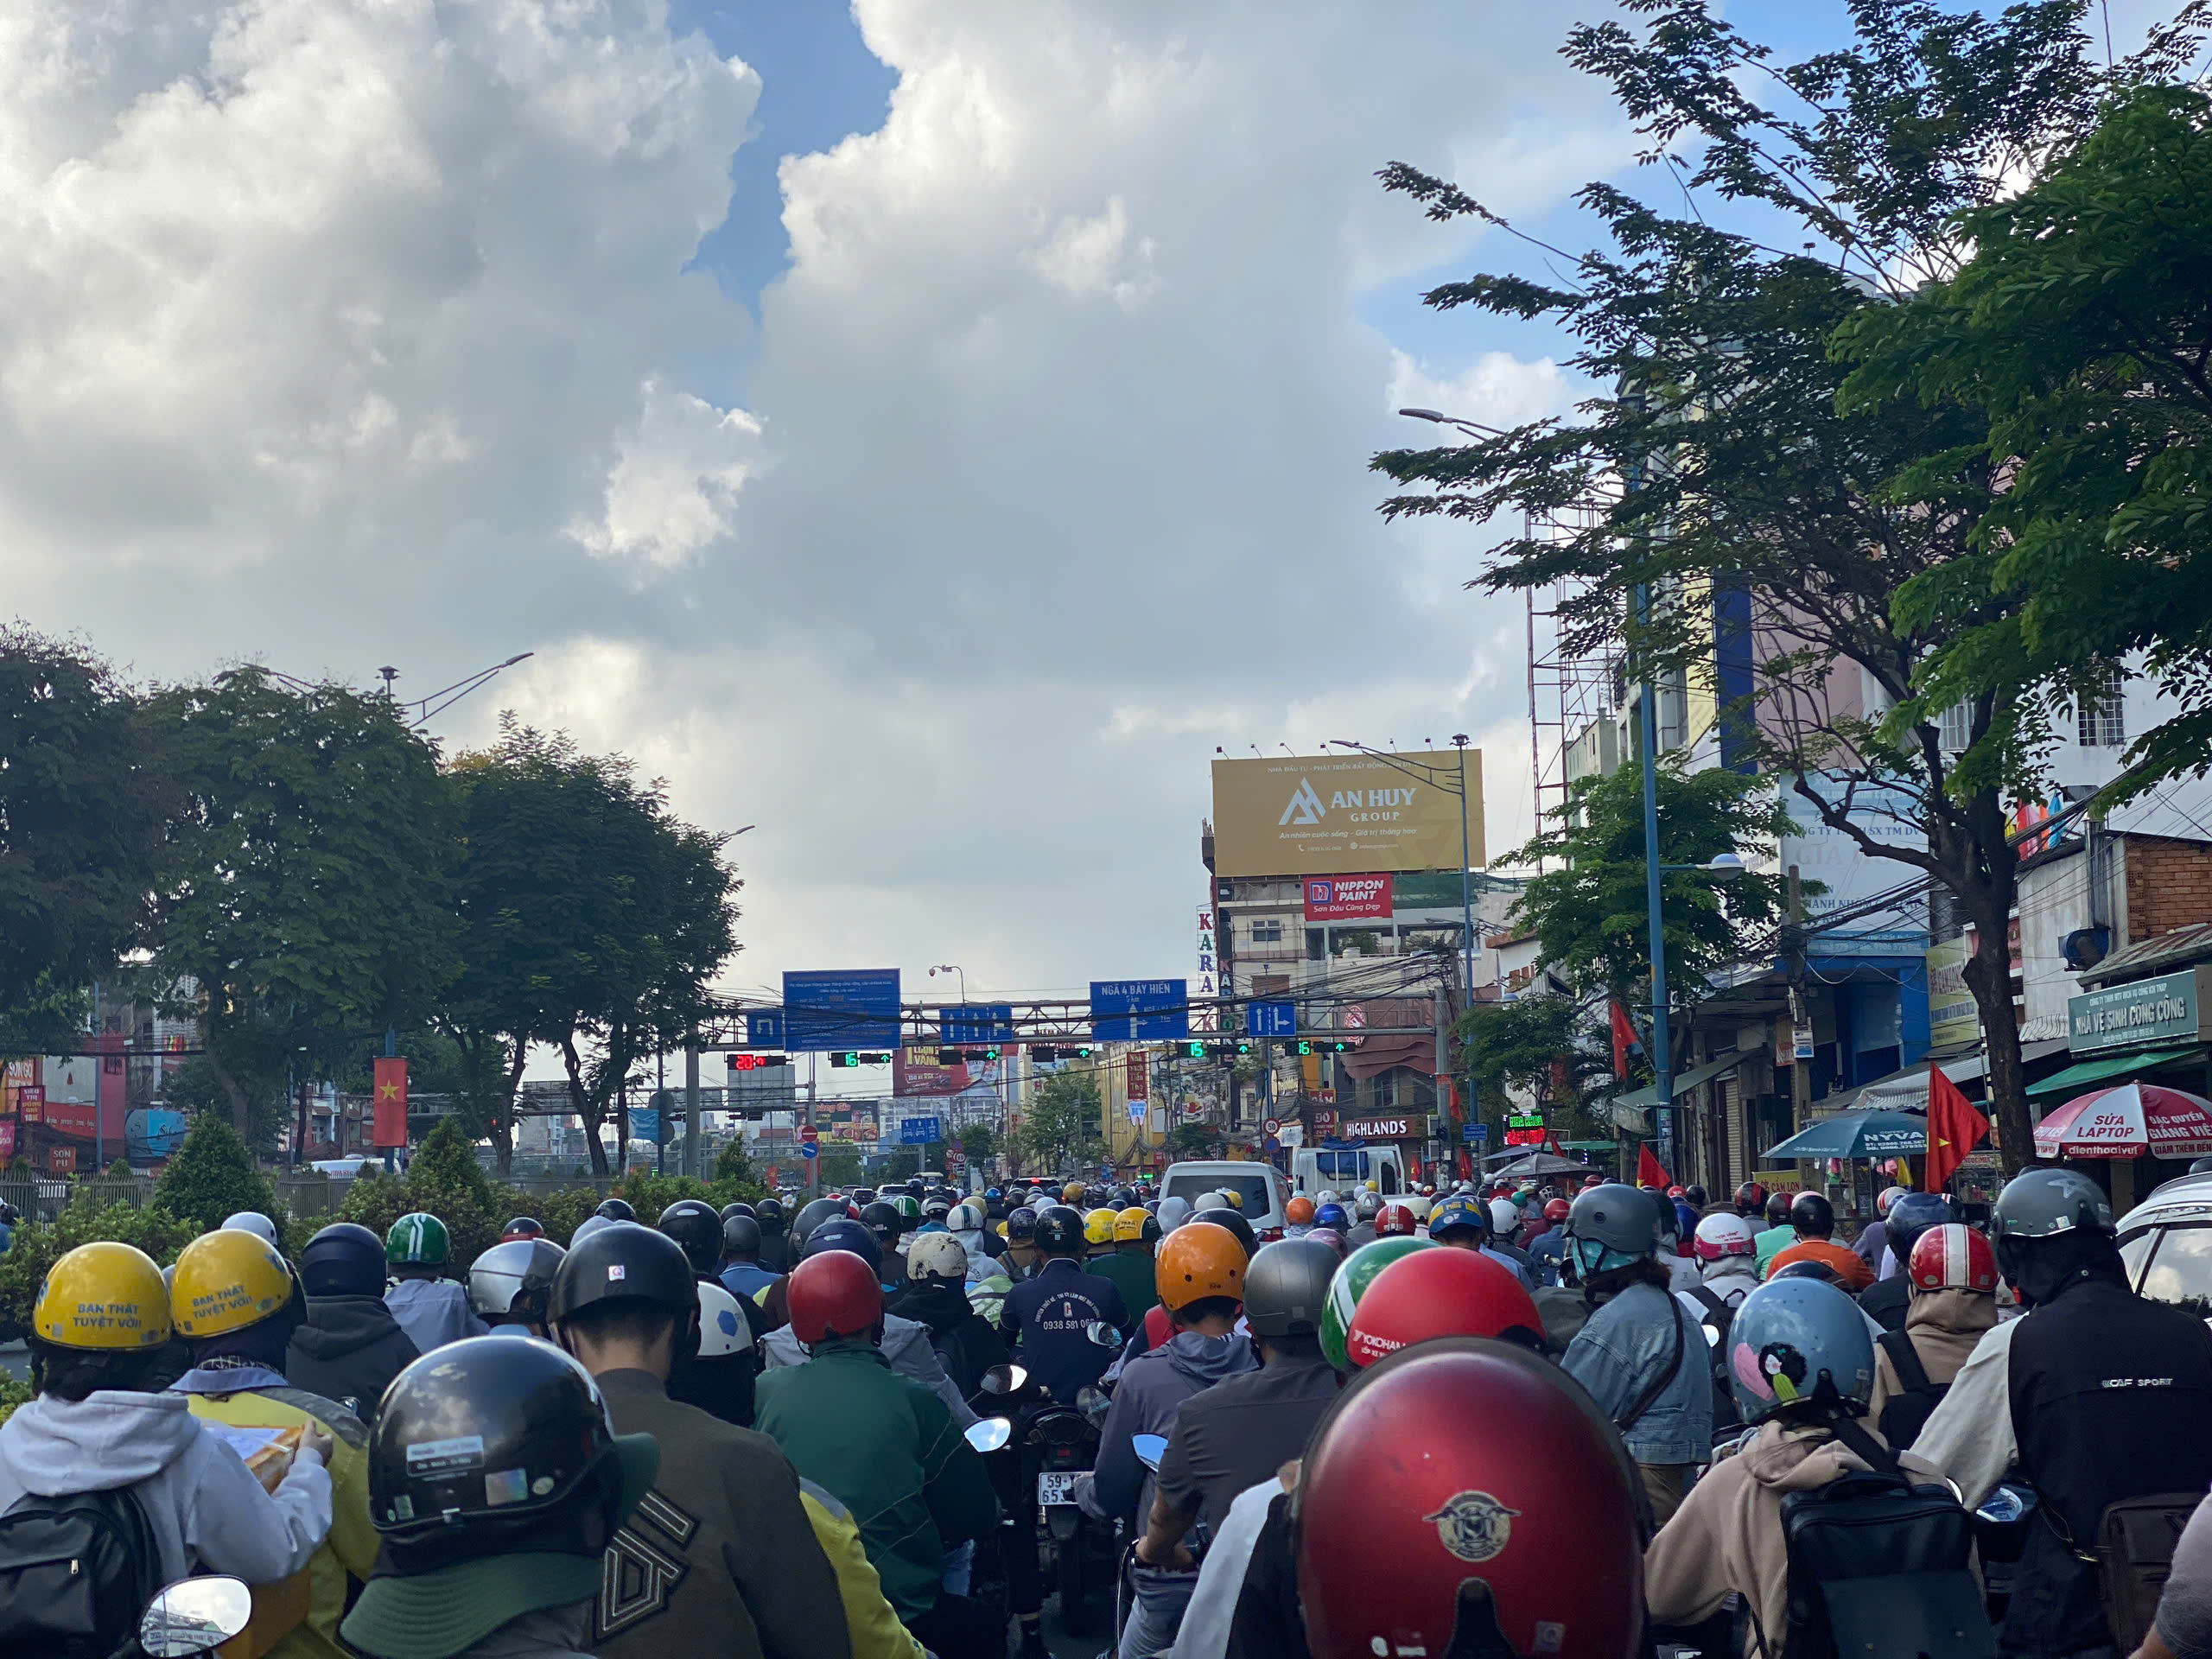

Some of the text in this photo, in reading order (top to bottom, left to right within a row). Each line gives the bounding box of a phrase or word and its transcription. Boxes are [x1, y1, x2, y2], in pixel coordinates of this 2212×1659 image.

[1331, 787, 1418, 809] AN HUY
[1351, 811, 1401, 823] GROUP
[1885, 827, 1902, 836] TM
[1335, 880, 1384, 892] NIPPON
[1338, 890, 1377, 901] PAINT
[1101, 983, 1120, 995] NGÃ
[1122, 986, 1128, 995] 4
[2075, 1009, 2092, 1036] NHÀ
[2094, 1008, 2105, 1036] VỆ
[2107, 1007, 2127, 1031] SINH
[2129, 1001, 2155, 1027] CÔNG
[2157, 994, 2186, 1027] CỘNG
[1191, 1042, 1203, 1057] 15
[1298, 1041, 1310, 1055] 16
[736, 1055, 753, 1070] 20
[845, 1052, 856, 1066] 16
[2094, 1112, 2125, 1126] SỬA
[1346, 1120, 1407, 1137] HIGHLANDS
[2076, 1127, 2134, 1138] LAPTOP
[2190, 1123, 2212, 1137] VIÊ
[1863, 1131, 1925, 1141] NYVA
[2069, 1145, 2138, 1156] dienthoaivui
[1043, 1319, 1065, 1331] 0938
[1065, 1319, 1078, 1330] 581
[2137, 1377, 2173, 1387] SPORT
